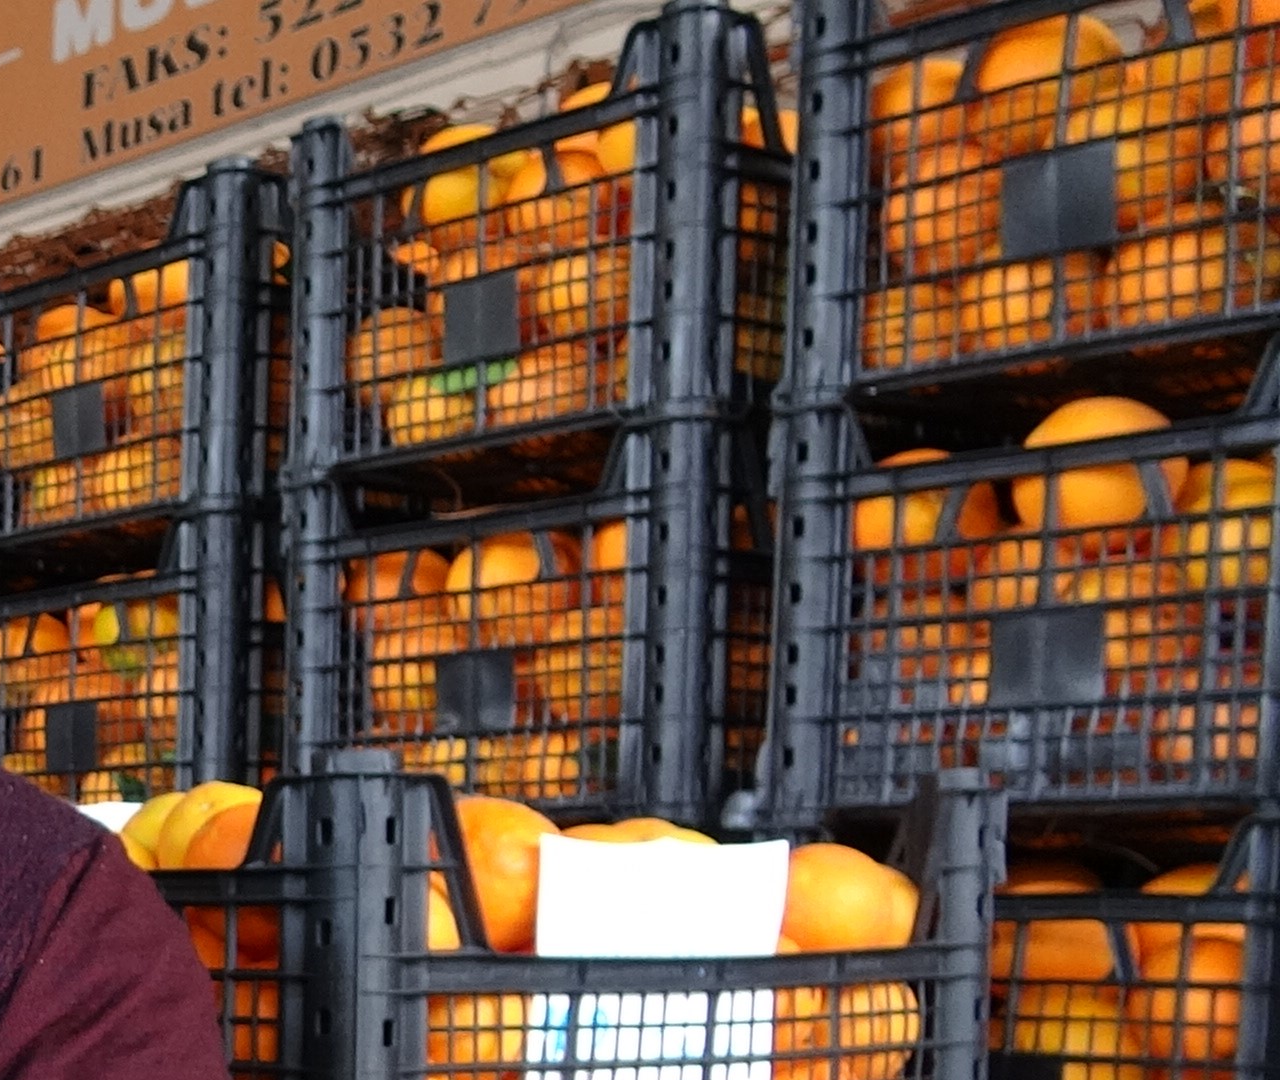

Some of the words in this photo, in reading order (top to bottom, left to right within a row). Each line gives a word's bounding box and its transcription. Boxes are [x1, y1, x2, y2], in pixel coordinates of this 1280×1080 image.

[79, 98, 192, 163] Musa
[212, 57, 290, 117] tel:
[309, 0, 444, 82] 0532
[81, 21, 228, 109] FAKS:
[0, 145, 44, 192] 61
